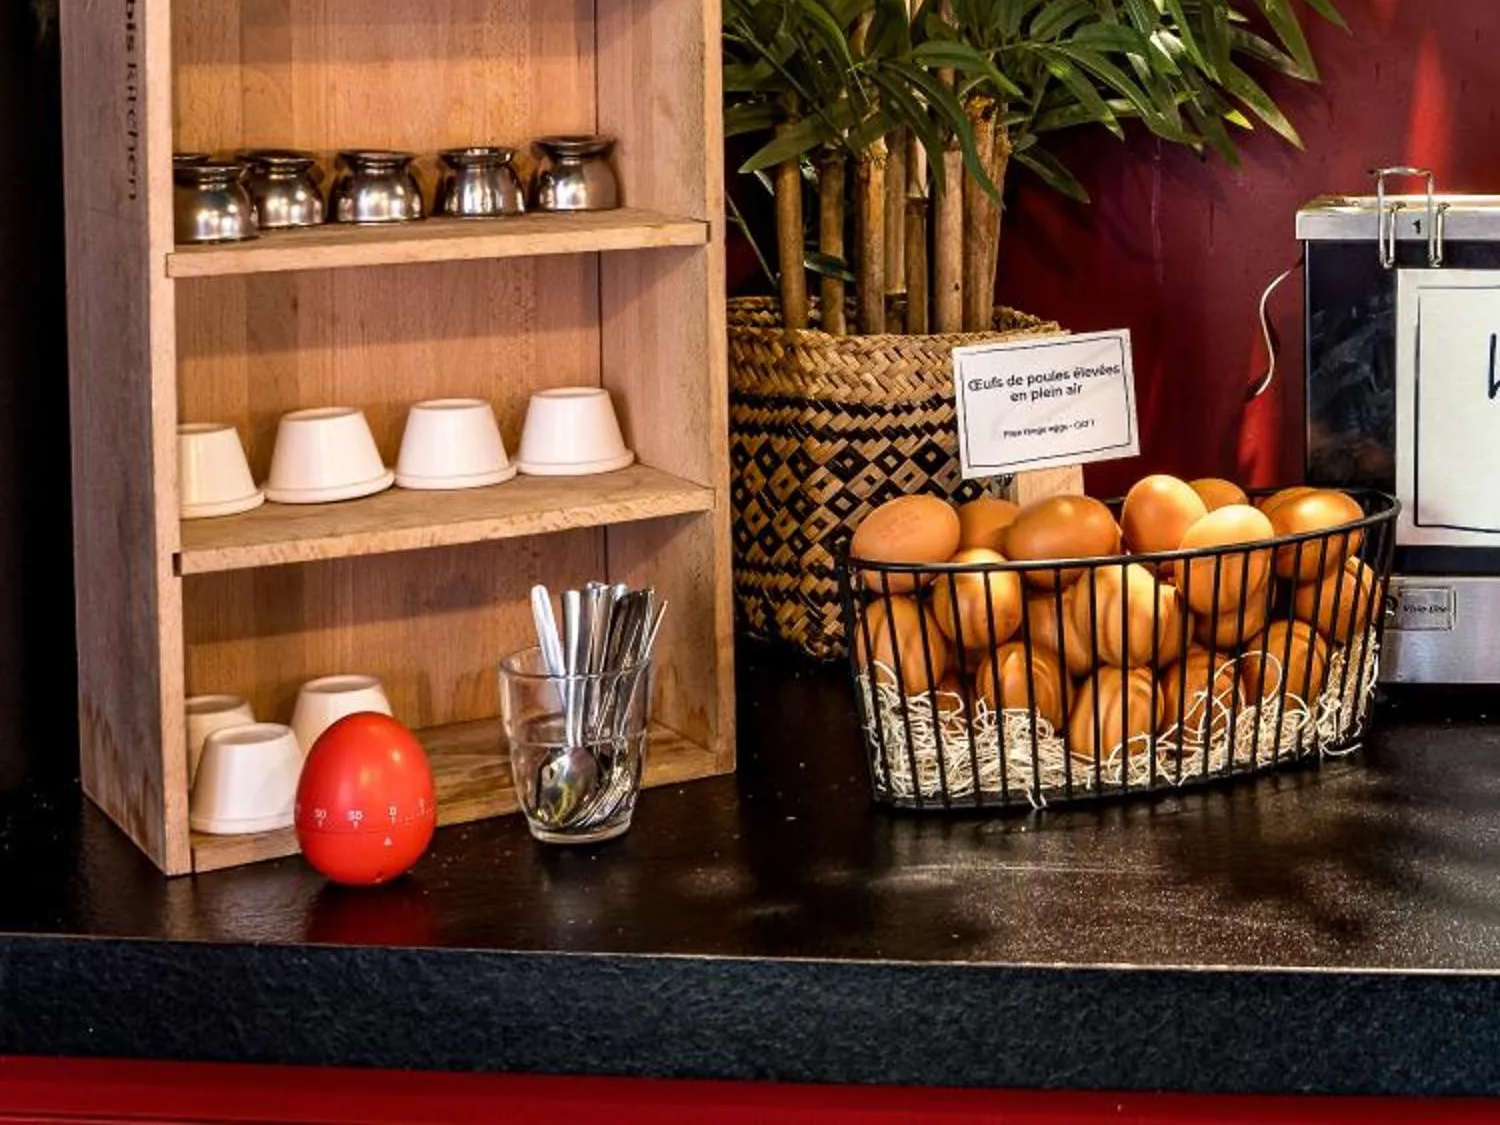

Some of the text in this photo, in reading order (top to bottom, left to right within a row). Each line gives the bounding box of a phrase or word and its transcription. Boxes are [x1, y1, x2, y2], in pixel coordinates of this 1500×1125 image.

[1412, 220, 1421, 235] 1
[1006, 375, 1023, 388] de
[1027, 370, 1071, 386] poules
[1010, 383, 1083, 403] en plein air
